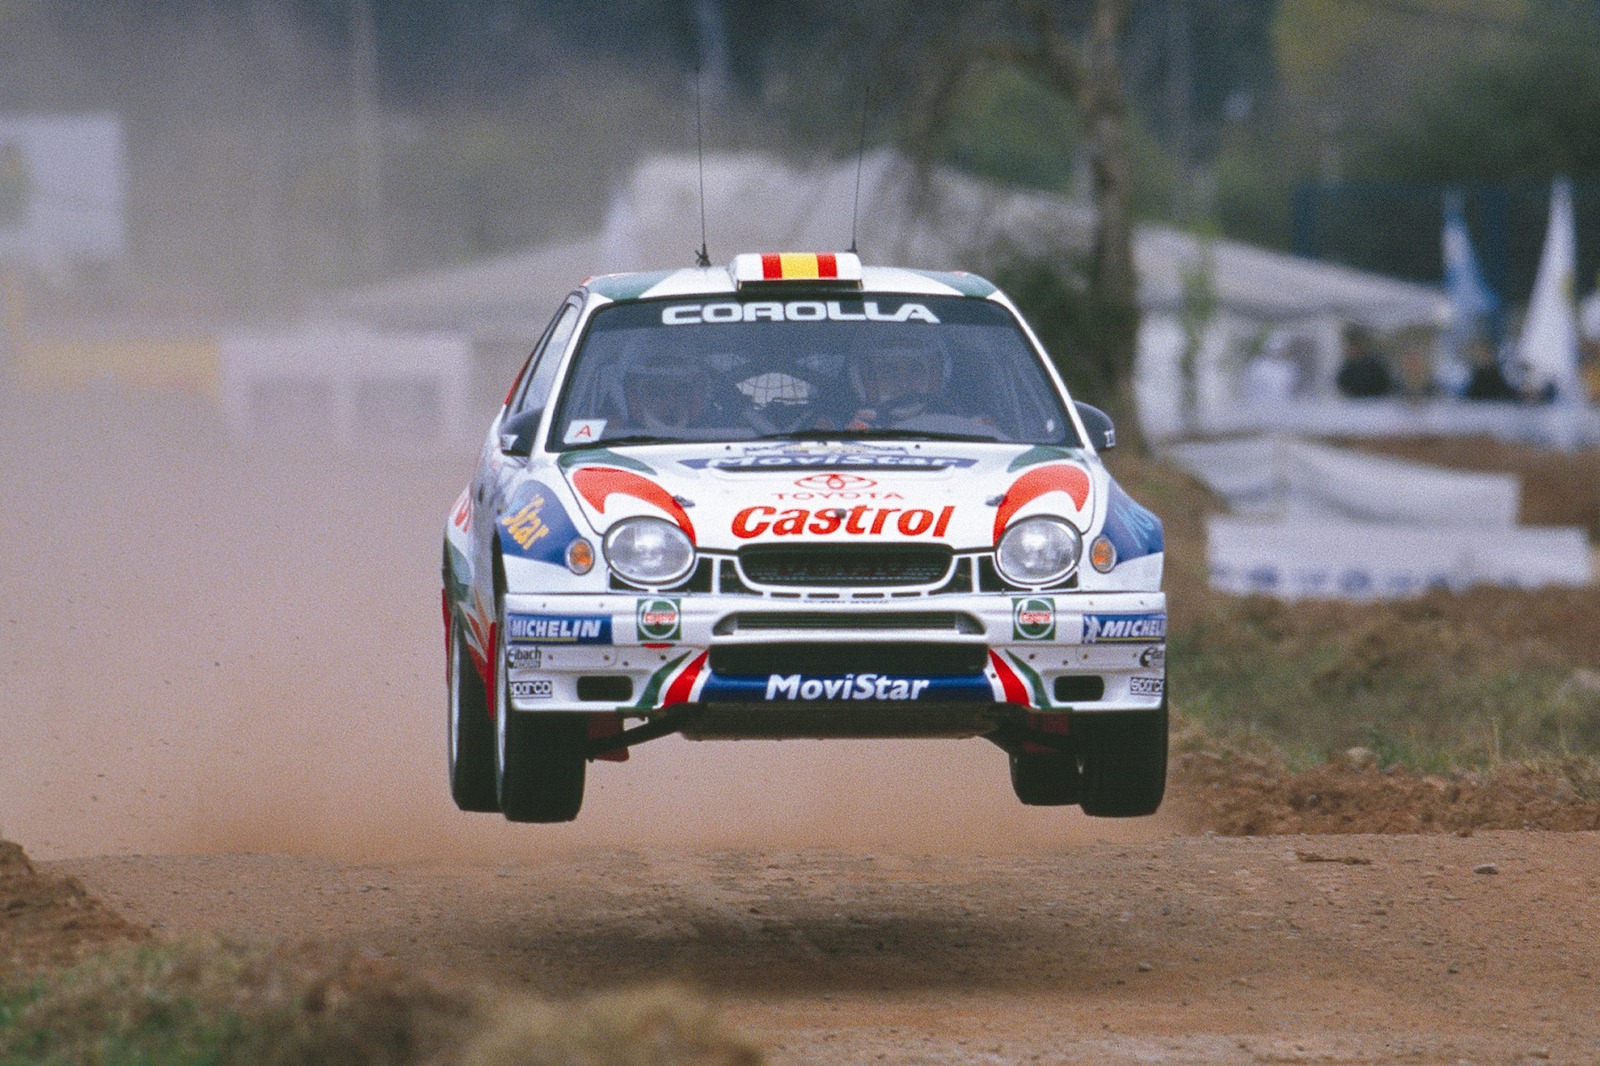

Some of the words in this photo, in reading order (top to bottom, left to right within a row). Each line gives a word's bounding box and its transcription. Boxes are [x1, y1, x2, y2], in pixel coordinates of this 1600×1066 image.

[662, 301, 941, 326] COROLLA
[574, 424, 592, 438] A
[706, 454, 958, 468] MoviStar
[773, 491, 905, 500] TOYOTA
[731, 503, 955, 539] Castrol
[510, 619, 601, 637] MICHELIN
[765, 674, 930, 700] MoviStar
